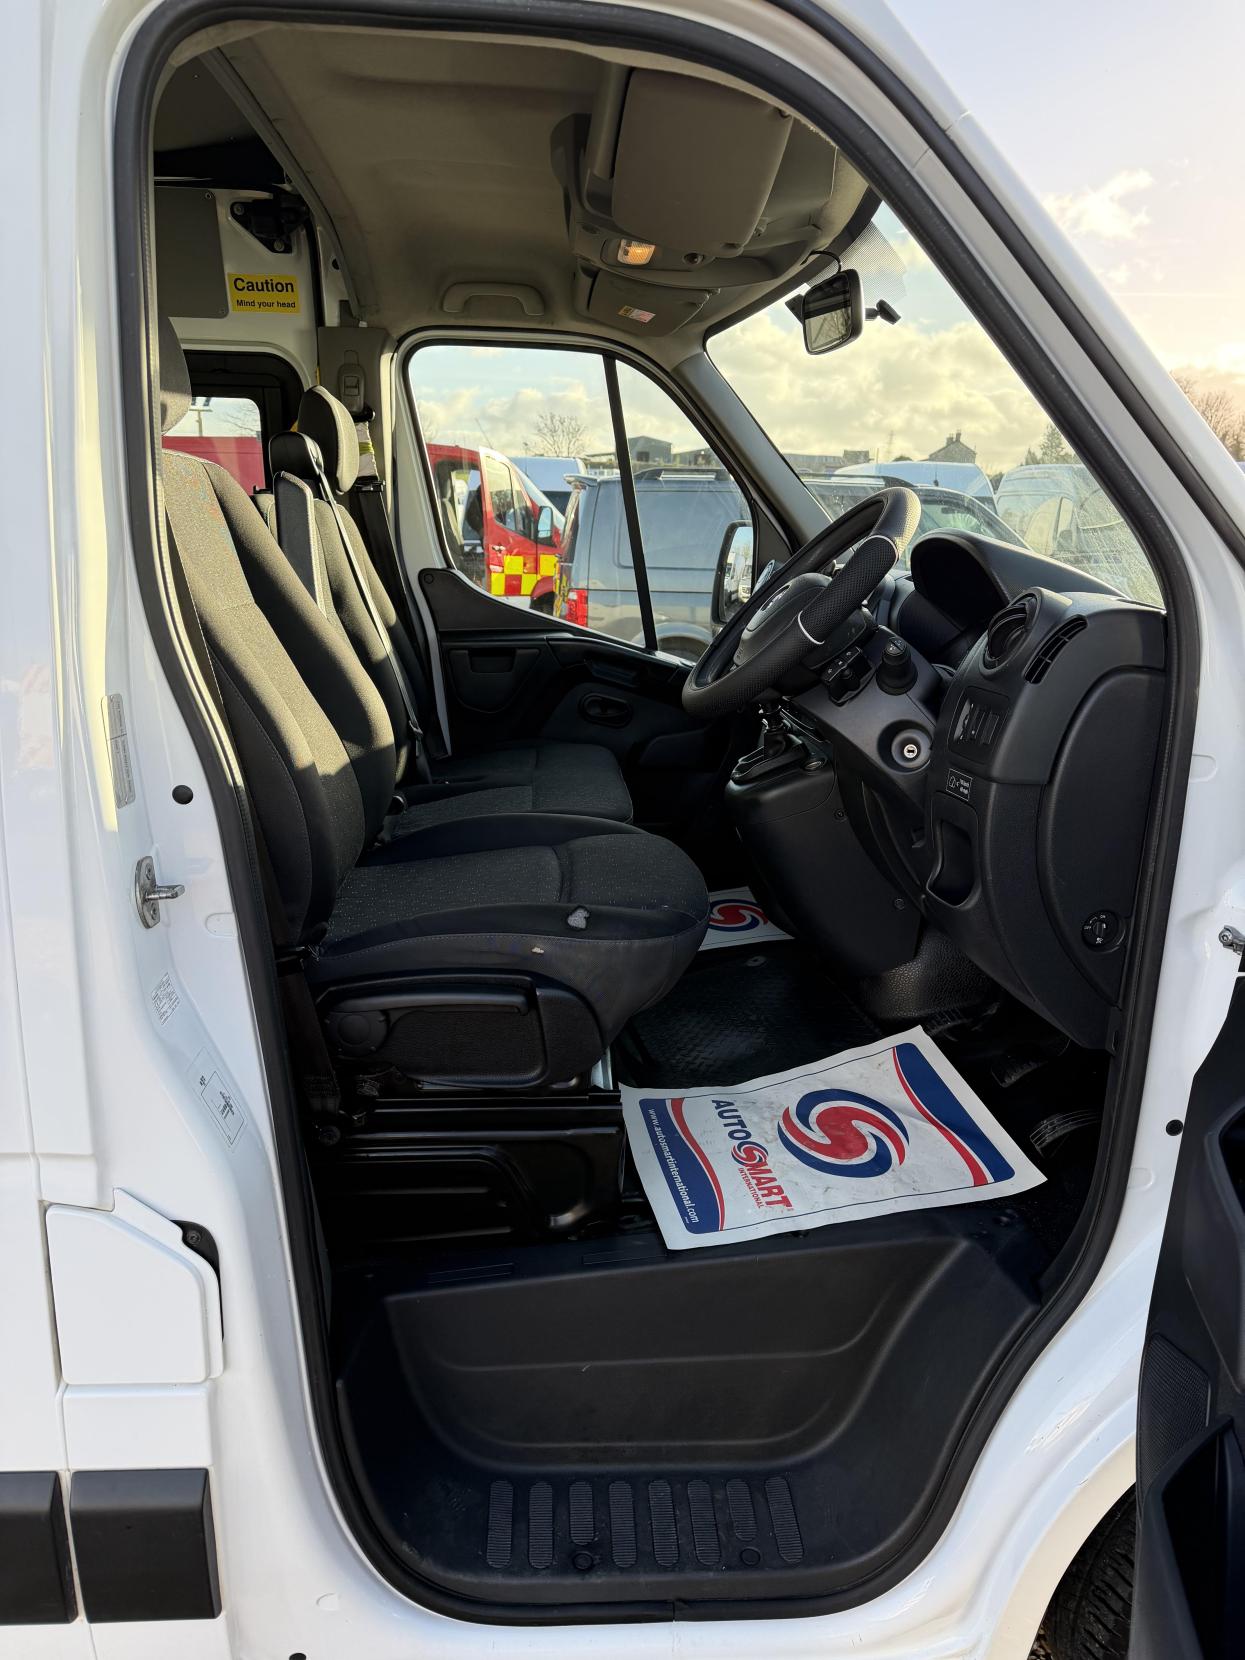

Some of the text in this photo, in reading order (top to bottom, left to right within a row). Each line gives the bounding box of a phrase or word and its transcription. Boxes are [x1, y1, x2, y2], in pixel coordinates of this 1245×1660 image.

[234, 278, 294, 293] Caution
[257, 301, 275, 309] your
[648, 1108, 700, 1224] www.autosmartinternational.com
[738, 1167, 765, 1208] INTERNATIONAL
